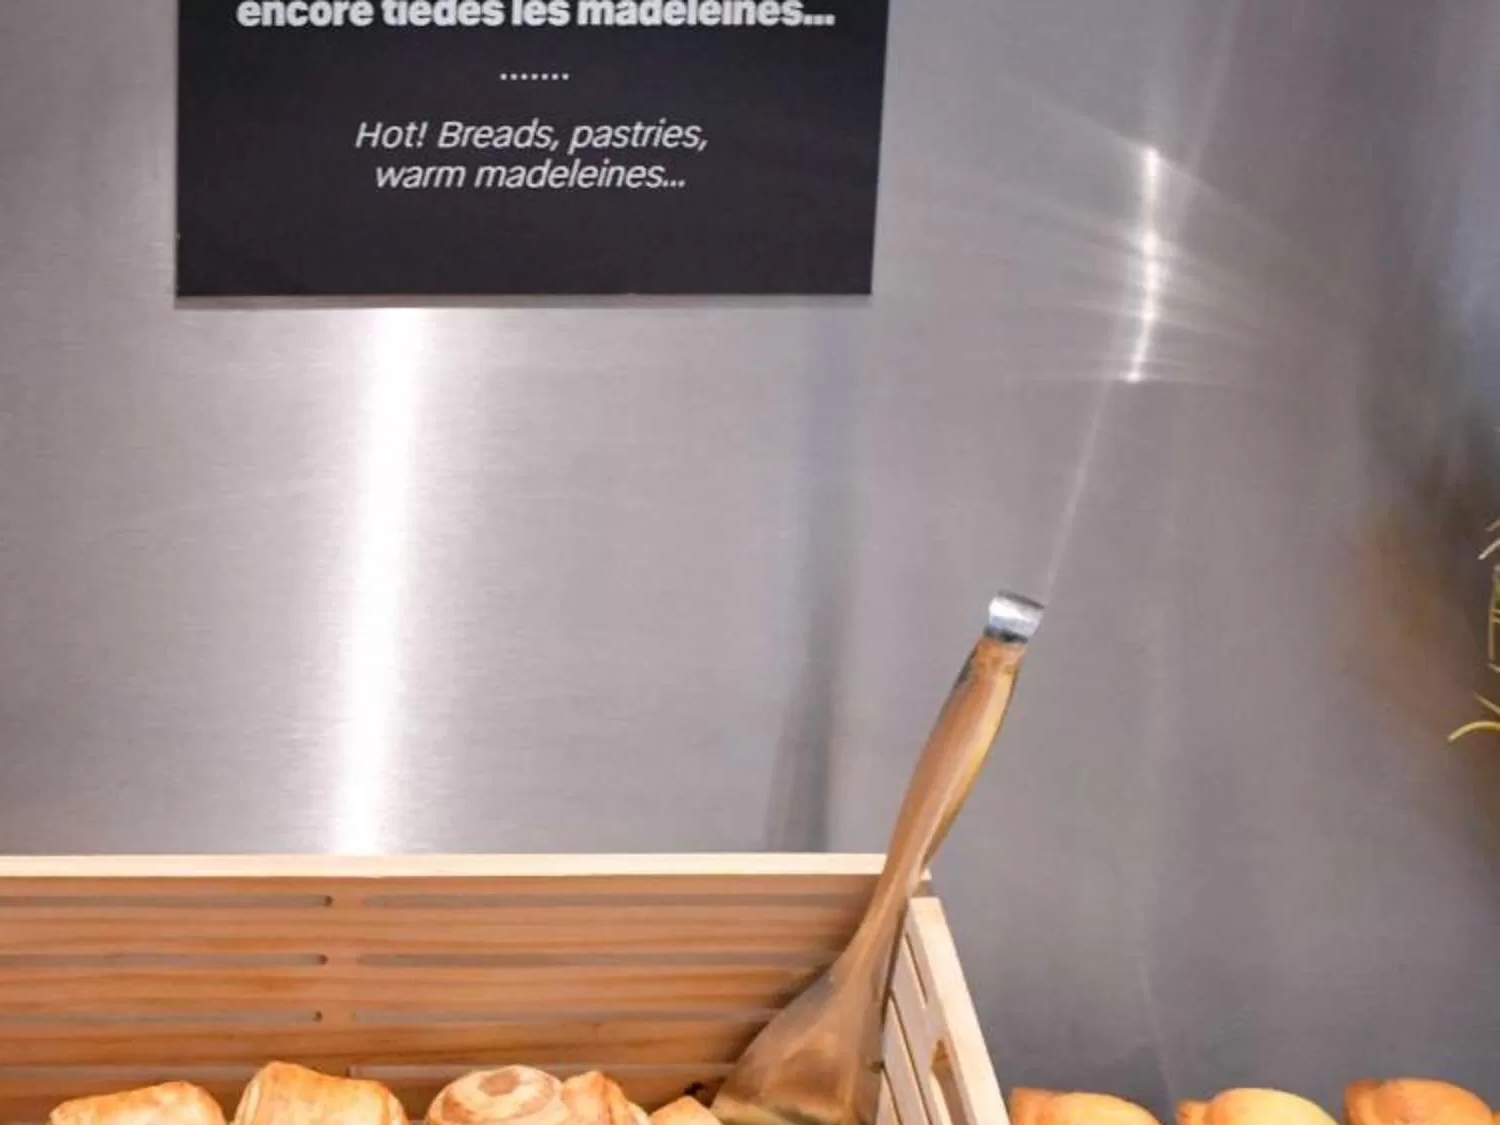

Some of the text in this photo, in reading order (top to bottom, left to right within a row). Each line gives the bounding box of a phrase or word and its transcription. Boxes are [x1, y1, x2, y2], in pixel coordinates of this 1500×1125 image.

[236, 0, 375, 27] encore
[511, 0, 570, 26] les
[355, 118, 708, 155] Hot! Breads, pastries,
[375, 158, 687, 188] warm madeleines...
